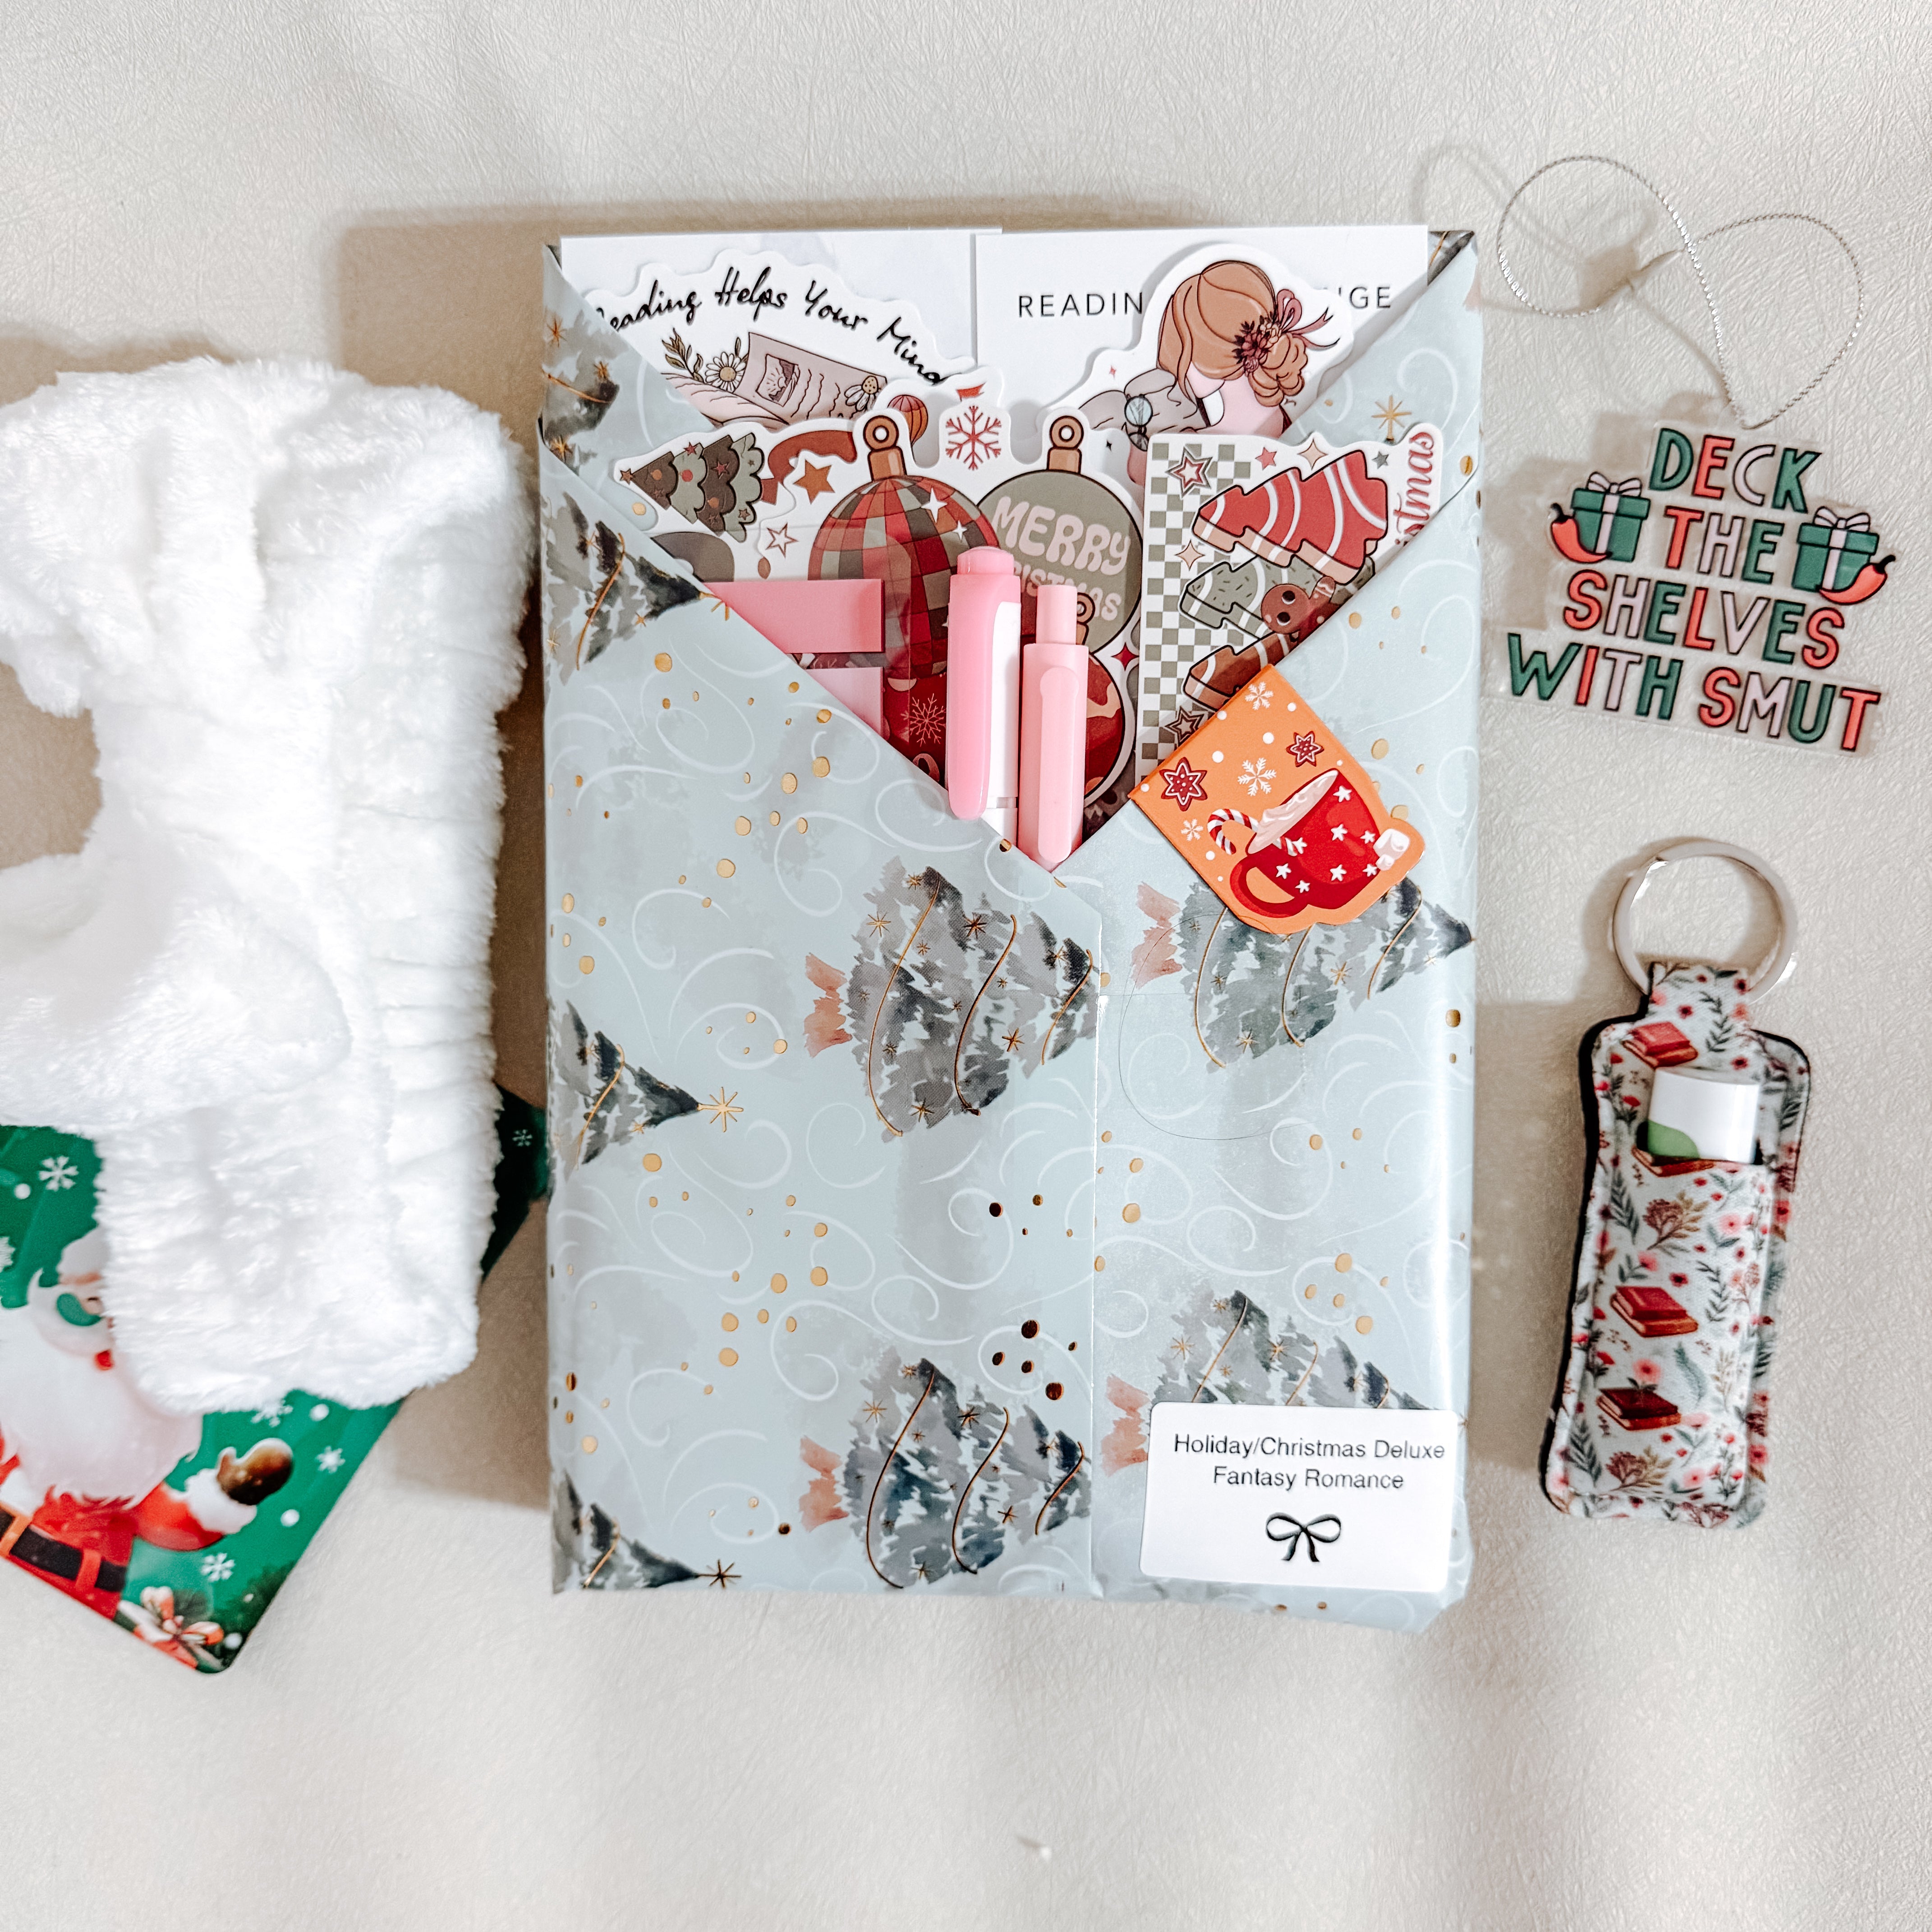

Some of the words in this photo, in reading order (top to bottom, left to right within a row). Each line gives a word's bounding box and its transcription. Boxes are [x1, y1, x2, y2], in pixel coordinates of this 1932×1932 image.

[595, 279, 702, 332] eading
[714, 266, 788, 322] Helps
[805, 280, 868, 330] Your
[1018, 291, 1143, 318] READIN
[1648, 428, 1822, 513] DECK
[992, 496, 1131, 575] MERRY
[1664, 505, 1785, 584] THE
[1563, 569, 1845, 669] SHELVES
[1507, 633, 1684, 720] WITH
[1698, 667, 1881, 752] SMUT
[1174, 1433, 1366, 1458] Holiday/Christmas
[1374, 1439, 1445, 1458] Deluxe
[1214, 1465, 1297, 1491] Fantasy
[1305, 1468, 1404, 1489] Romance
